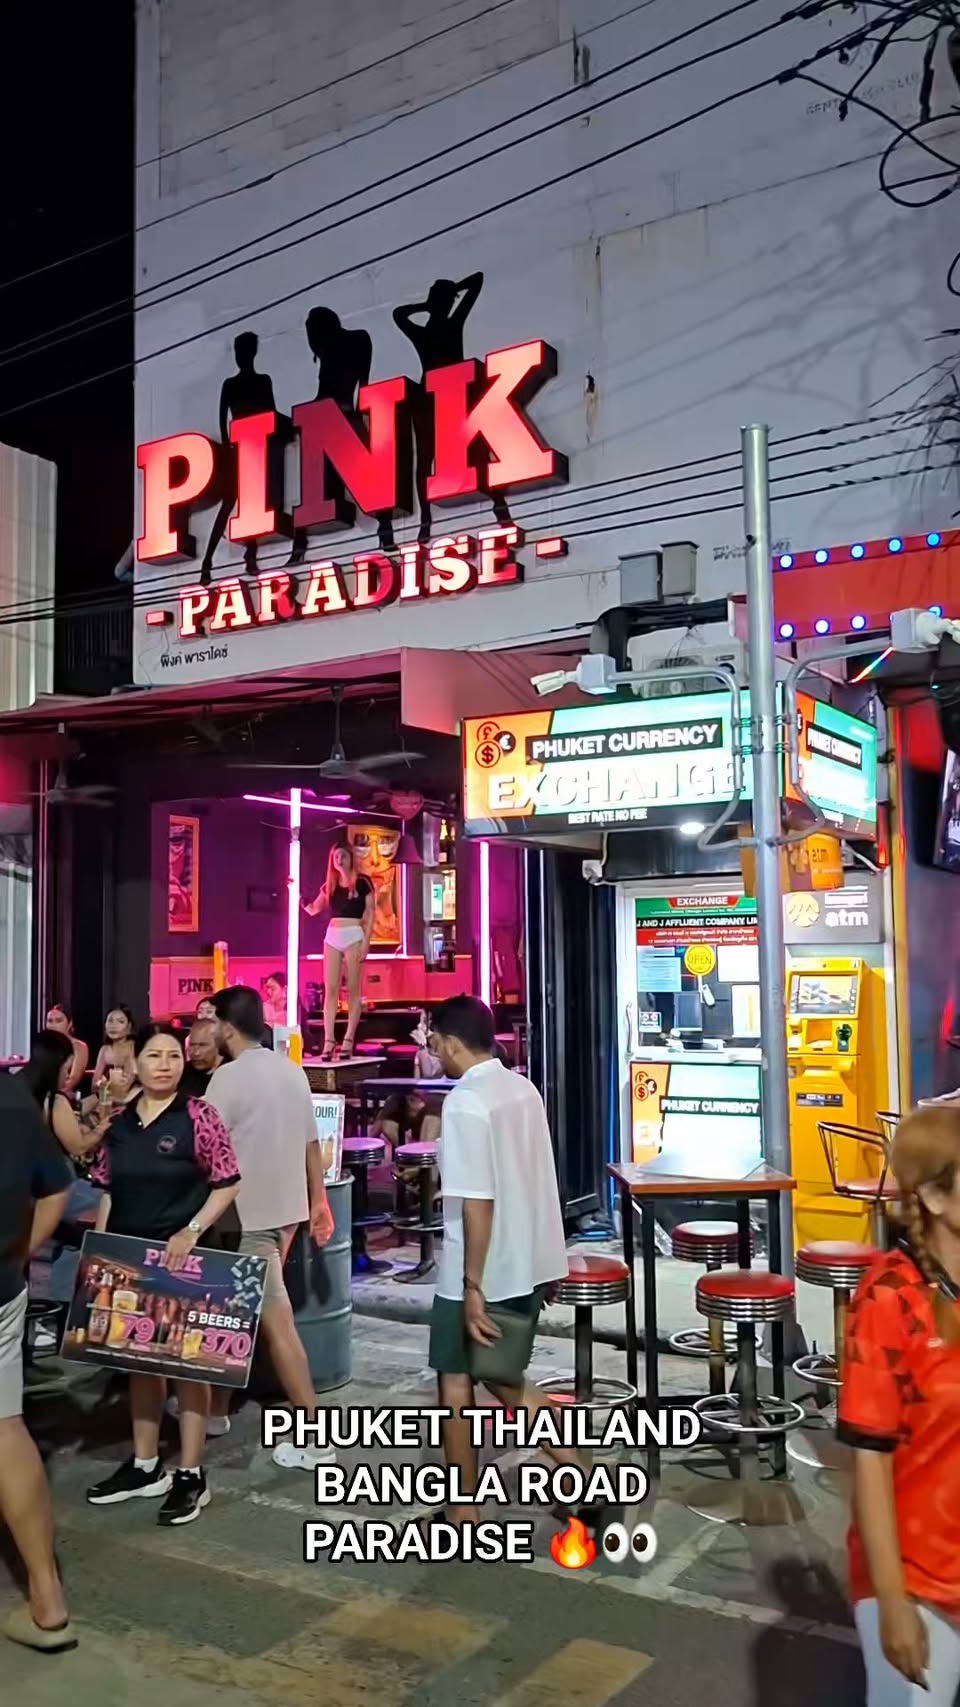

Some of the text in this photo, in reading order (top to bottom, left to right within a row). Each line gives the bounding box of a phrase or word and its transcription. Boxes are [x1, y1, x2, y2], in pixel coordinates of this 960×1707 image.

[137, 339, 562, 562] PINK
[178, 526, 522, 639] PARADISE
[532, 724, 719, 759] PHUKET CURRENCY
[488, 756, 745, 810] EXCHANGE
[568, 808, 648, 825] BEST RATE NO FEE
[677, 896, 728, 906] EXCHANGE
[665, 918, 704, 927] AFFLUENT
[705, 917, 745, 926] COMPANY
[825, 909, 869, 927] atm
[687, 954, 712, 965] OPEN
[178, 978, 213, 993] PINK
[313, 1106, 338, 1118] OUR!
[661, 1099, 760, 1114] PHUKET CURRENCY
[143, 1248, 204, 1273] PIK
[187, 1311, 196, 1322] 5
[199, 1313, 241, 1329] BEERS
[121, 1315, 155, 1344] 79
[201, 1328, 251, 1358] 370
